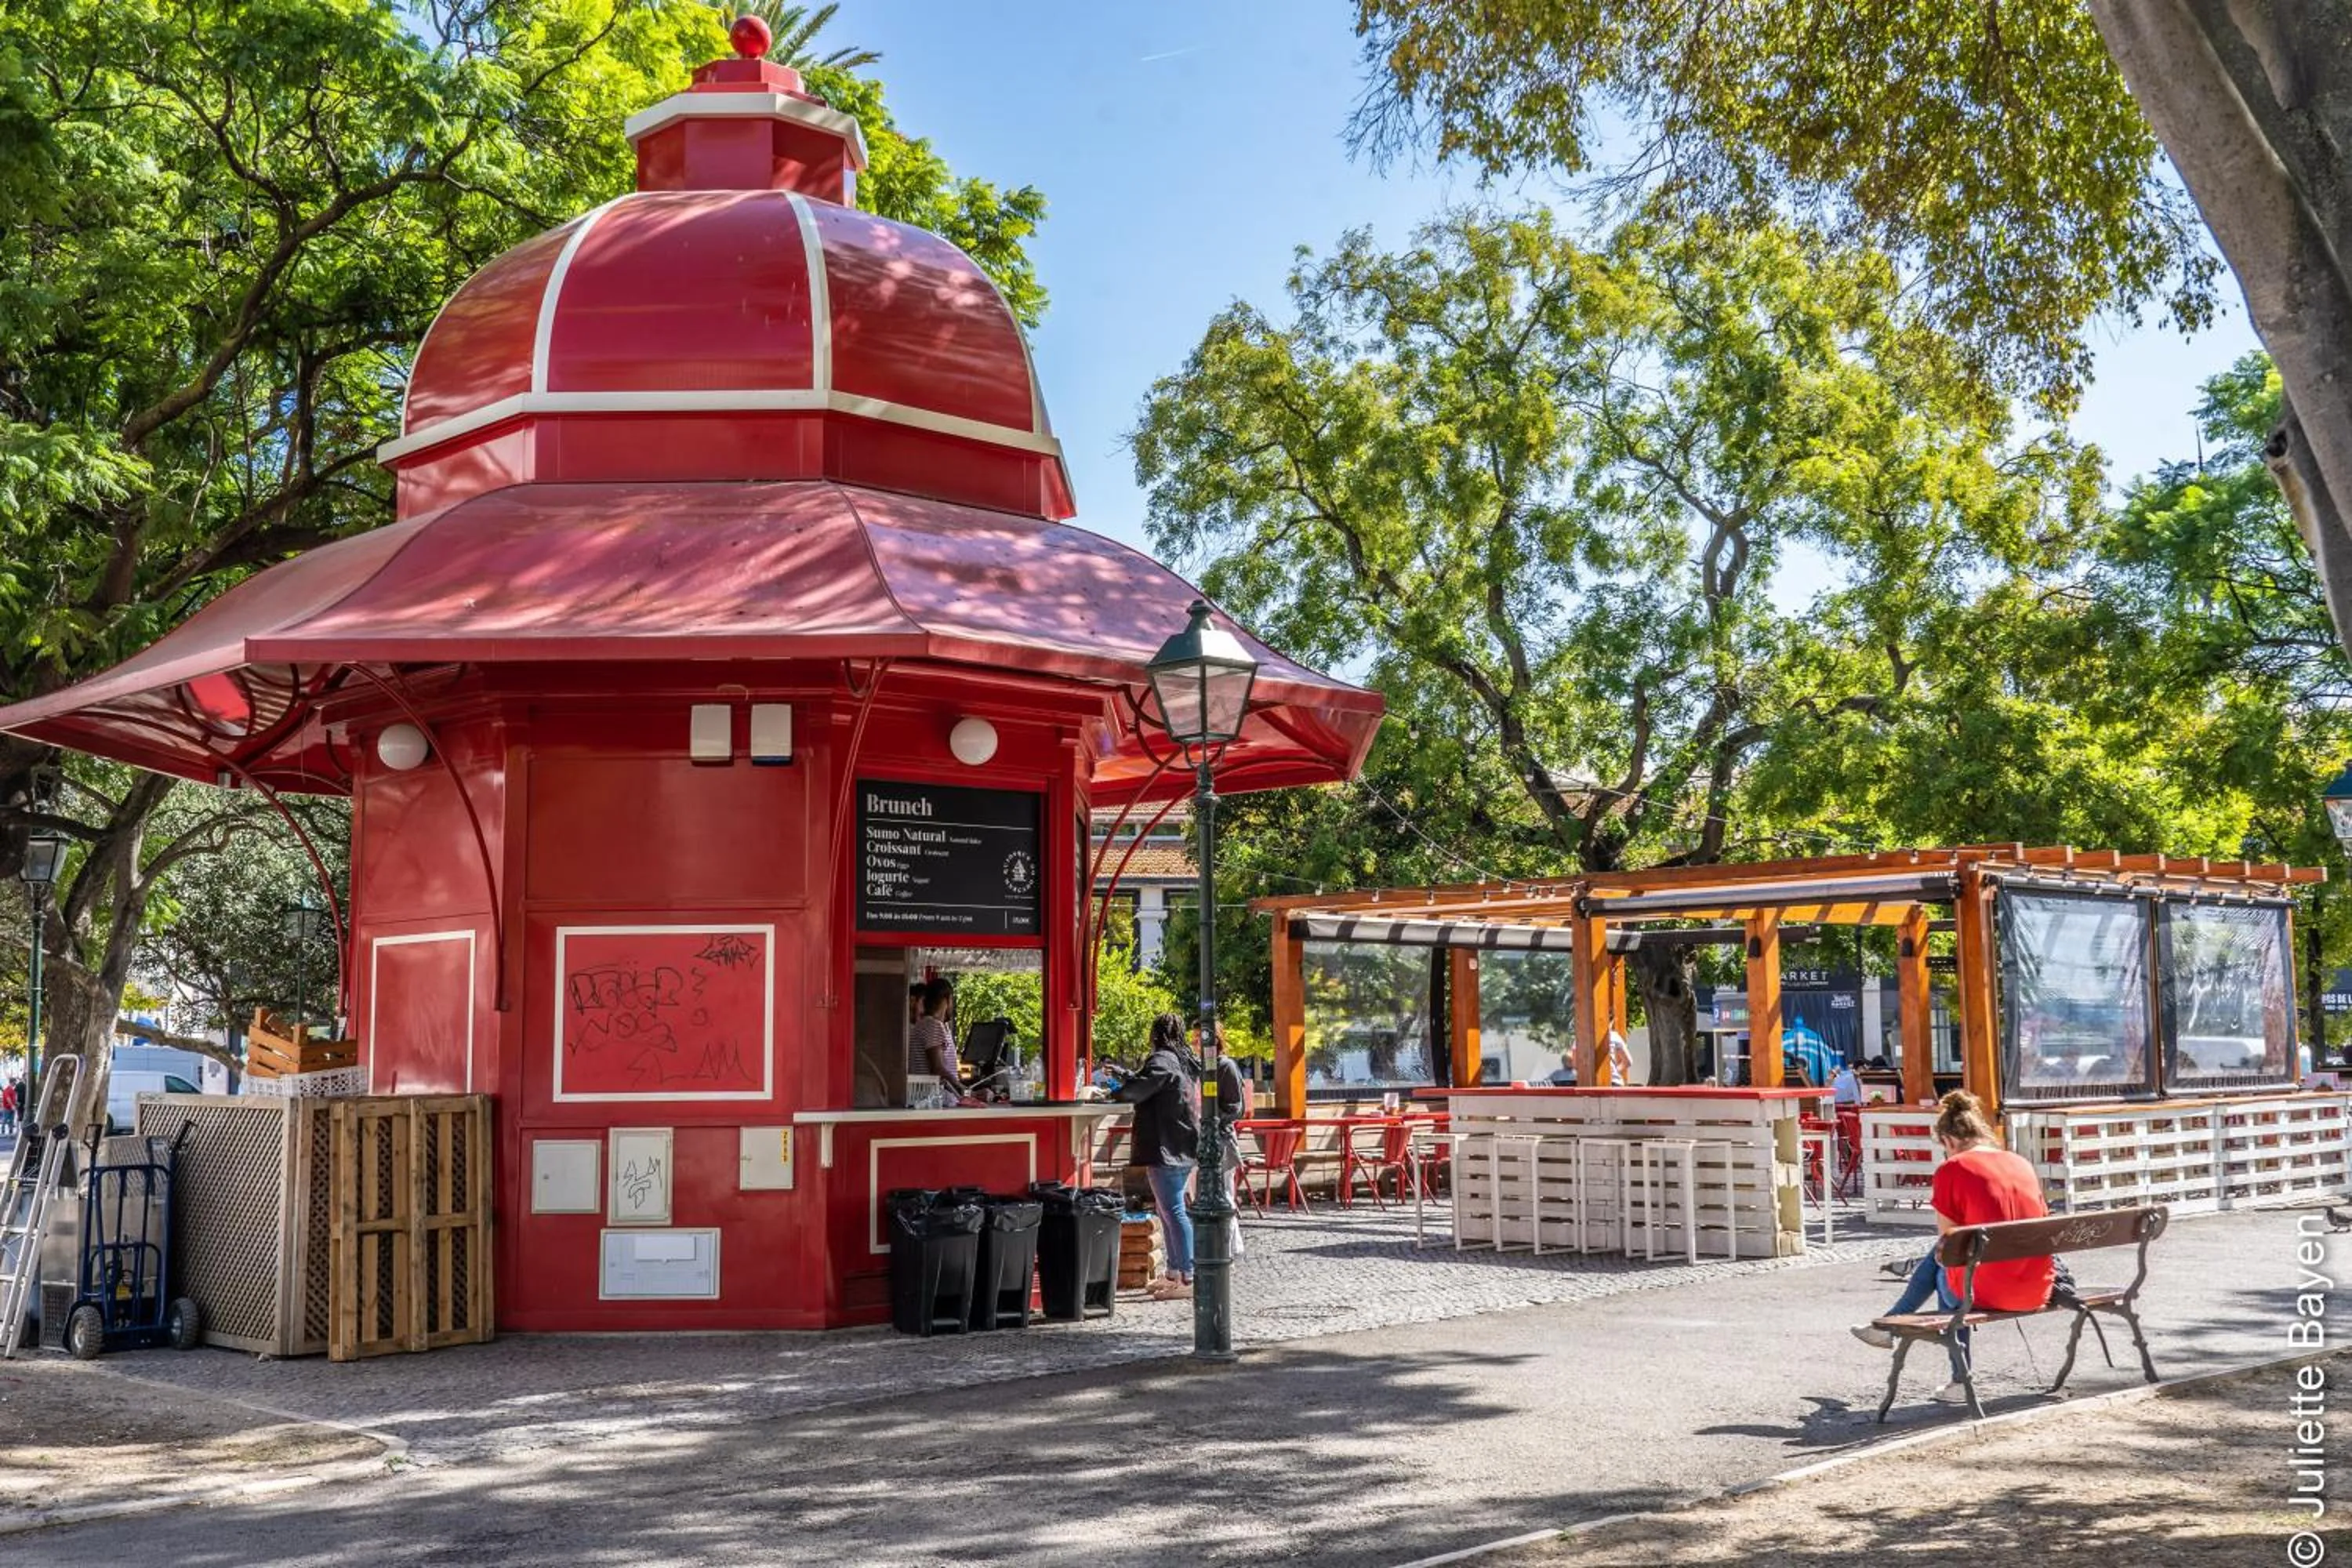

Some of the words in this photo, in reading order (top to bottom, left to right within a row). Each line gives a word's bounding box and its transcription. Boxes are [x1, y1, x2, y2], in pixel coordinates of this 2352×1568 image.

[866, 793, 932, 816] Brunch
[866, 826, 900, 840] Sumo
[903, 827, 946, 842] Natural
[866, 840, 921, 855] Croissant
[866, 855, 896, 868] Ovos
[866, 869, 909, 884] Iogurte
[866, 883, 893, 896] Café
[1781, 971, 1829, 980] ARKET
